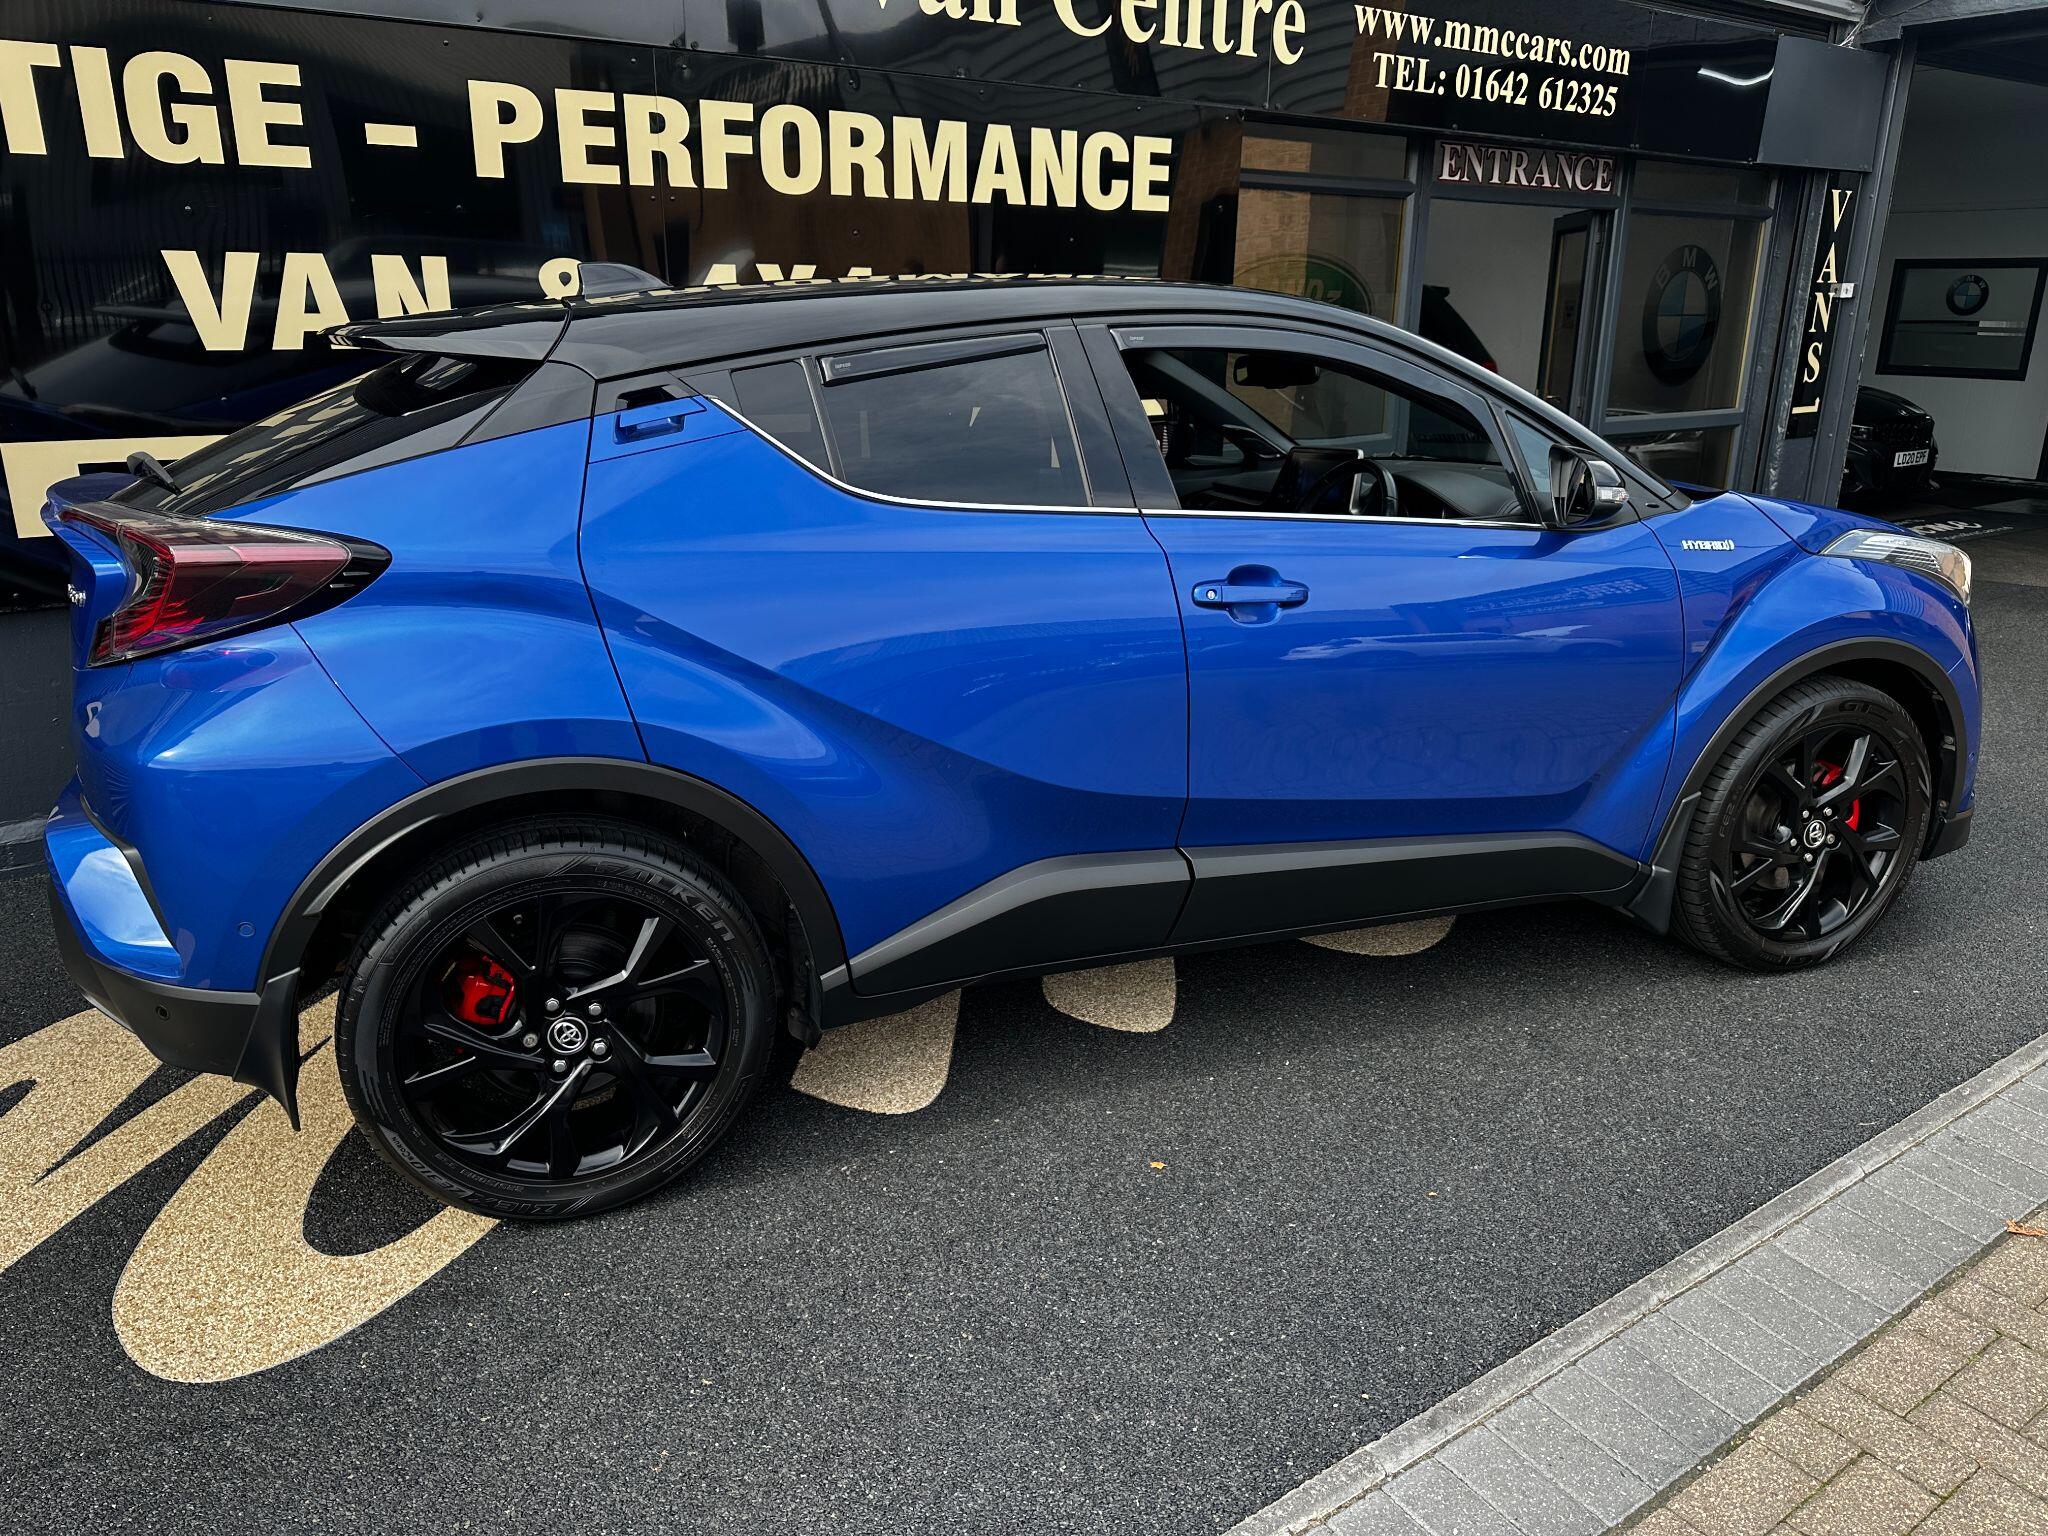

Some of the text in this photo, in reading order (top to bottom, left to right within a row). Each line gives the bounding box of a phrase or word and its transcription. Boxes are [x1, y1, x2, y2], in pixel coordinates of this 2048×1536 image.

[1354, 4, 1631, 76] www.mmccars.com
[1373, 52, 1619, 117] TEL: 01642 612325
[467, 80, 1173, 212] PERFORMANCE
[1439, 143, 1614, 192] ENTRANCE
[161, 250, 456, 351] VAN
[1803, 189, 1853, 383] VANS
